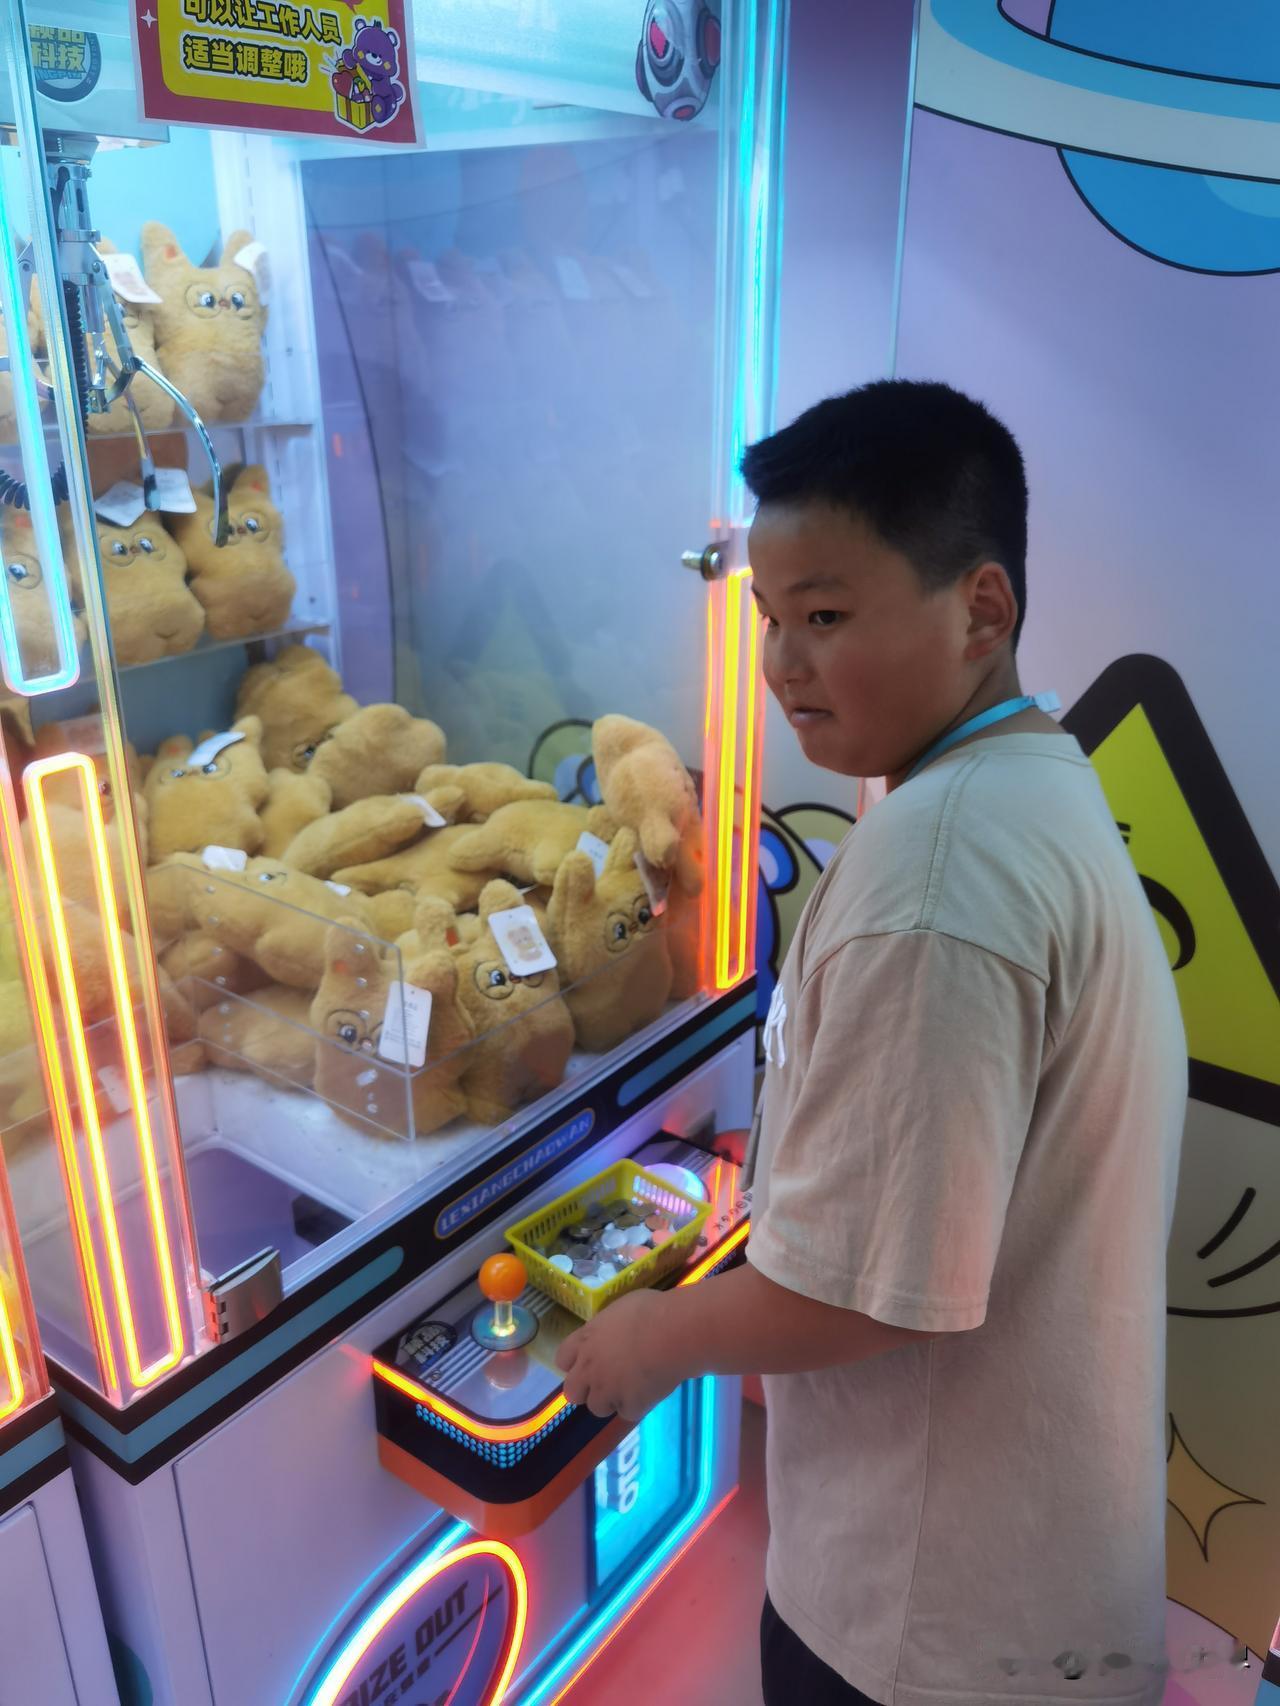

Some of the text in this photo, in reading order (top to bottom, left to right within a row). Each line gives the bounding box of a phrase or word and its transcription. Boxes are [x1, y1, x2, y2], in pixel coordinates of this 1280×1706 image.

[184, 0, 342, 46] 可以让工作人员
[31, 42, 87, 73] 科技
[183, 34, 308, 83] 适当调整哦
[415, 1580, 469, 1657] OUT
